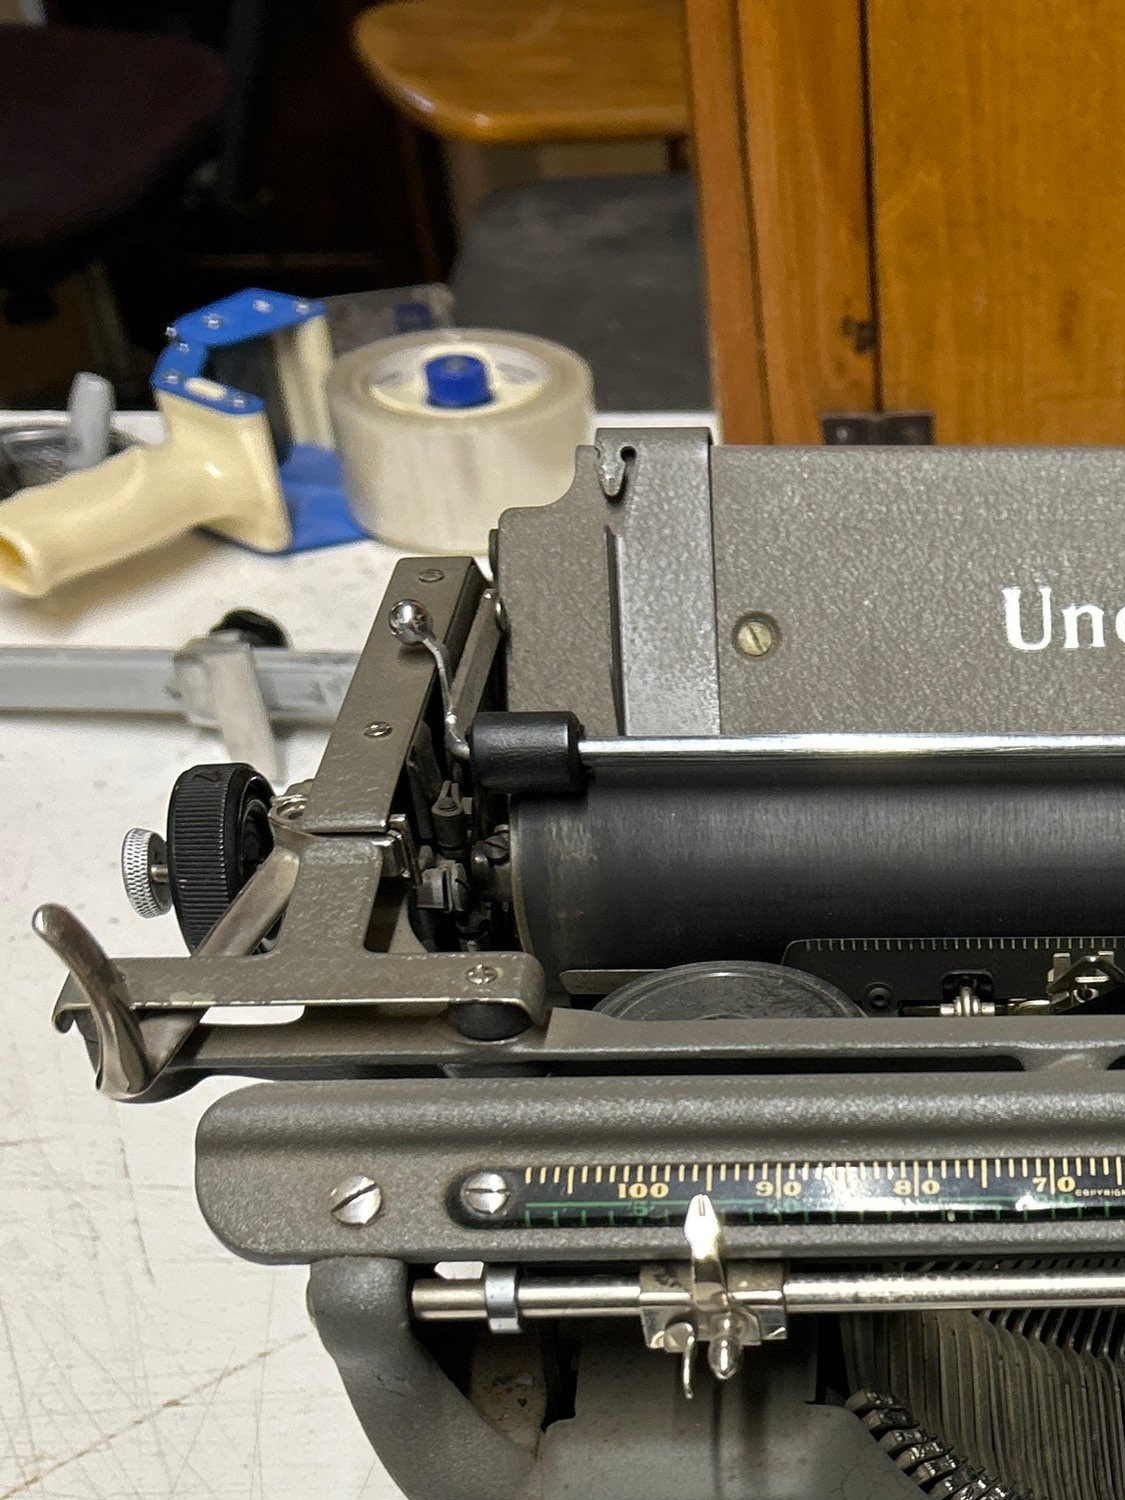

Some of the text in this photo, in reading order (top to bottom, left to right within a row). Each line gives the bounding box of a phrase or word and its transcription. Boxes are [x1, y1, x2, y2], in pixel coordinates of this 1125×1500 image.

[618, 1182, 669, 1199] 100
[755, 1180, 802, 1198] 90
[1031, 1175, 1076, 1193] 70
